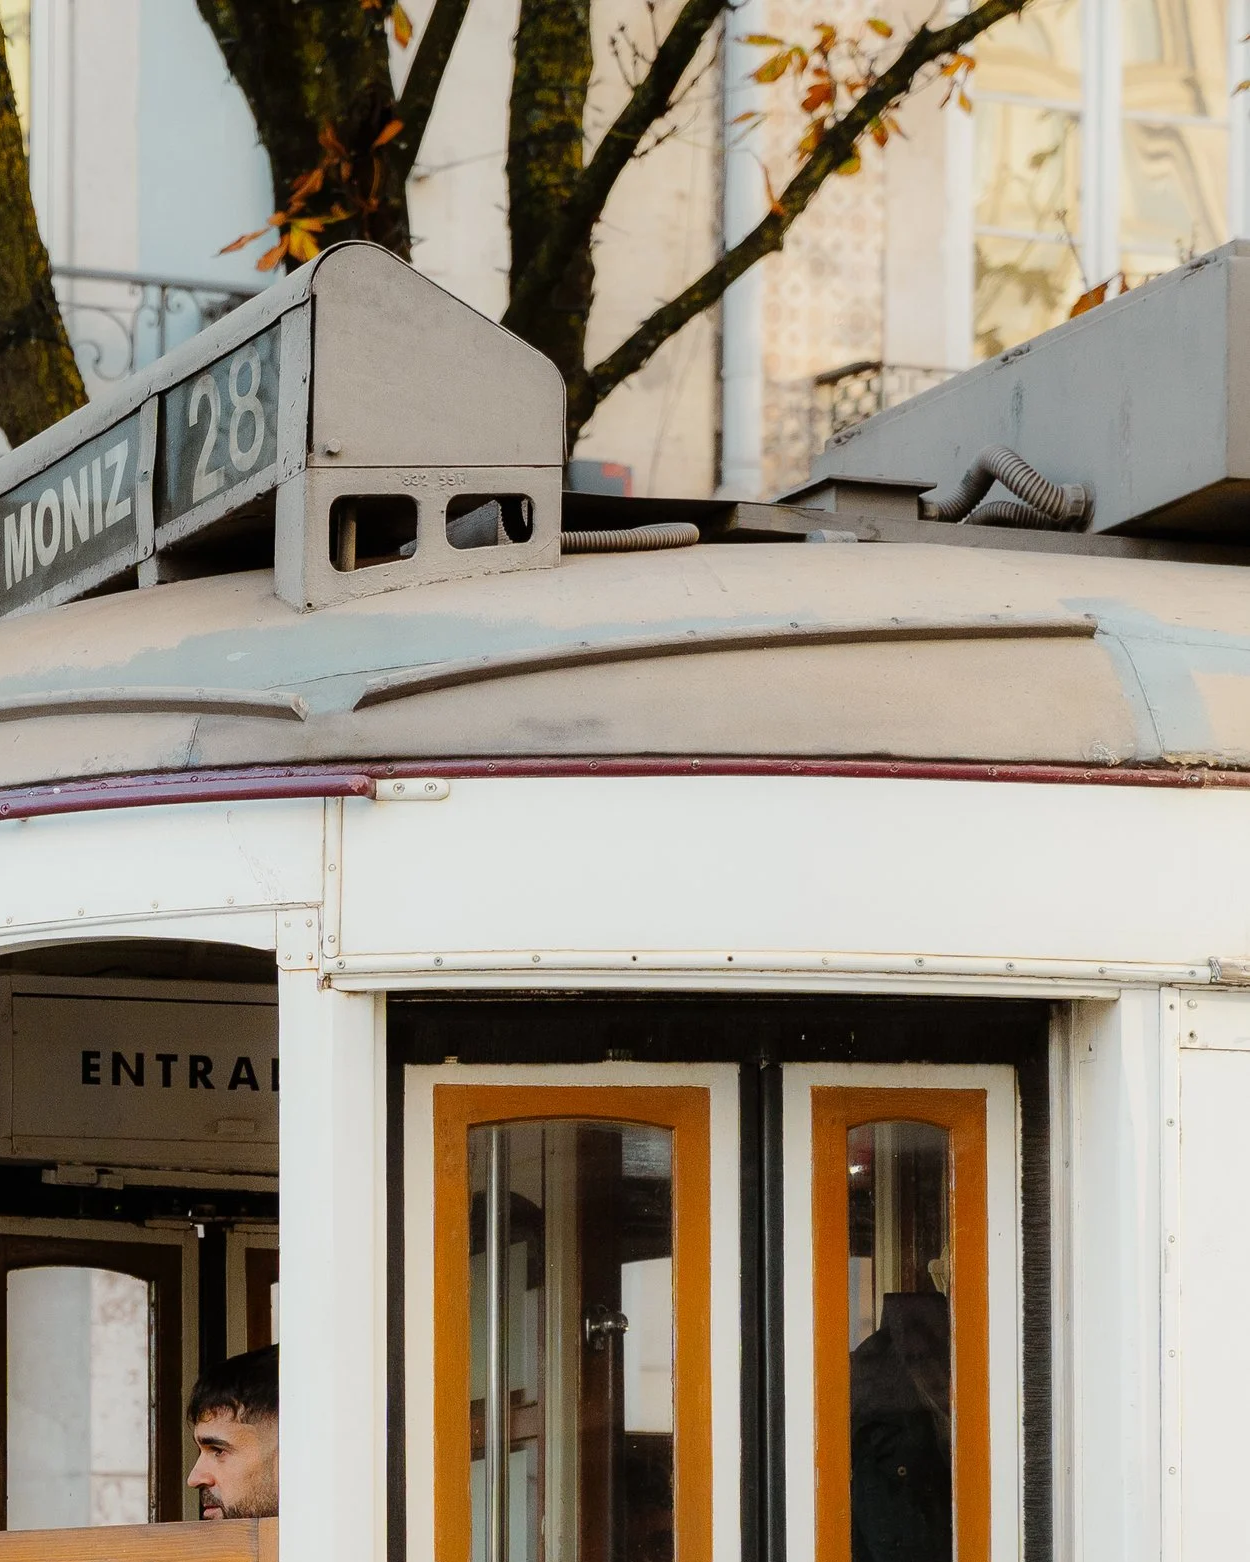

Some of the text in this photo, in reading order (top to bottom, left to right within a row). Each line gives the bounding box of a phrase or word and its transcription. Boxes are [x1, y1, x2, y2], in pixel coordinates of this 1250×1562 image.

[188, 345, 265, 505] 28
[3, 438, 132, 591] MONIZ
[81, 1050, 280, 1092] ENTRA
